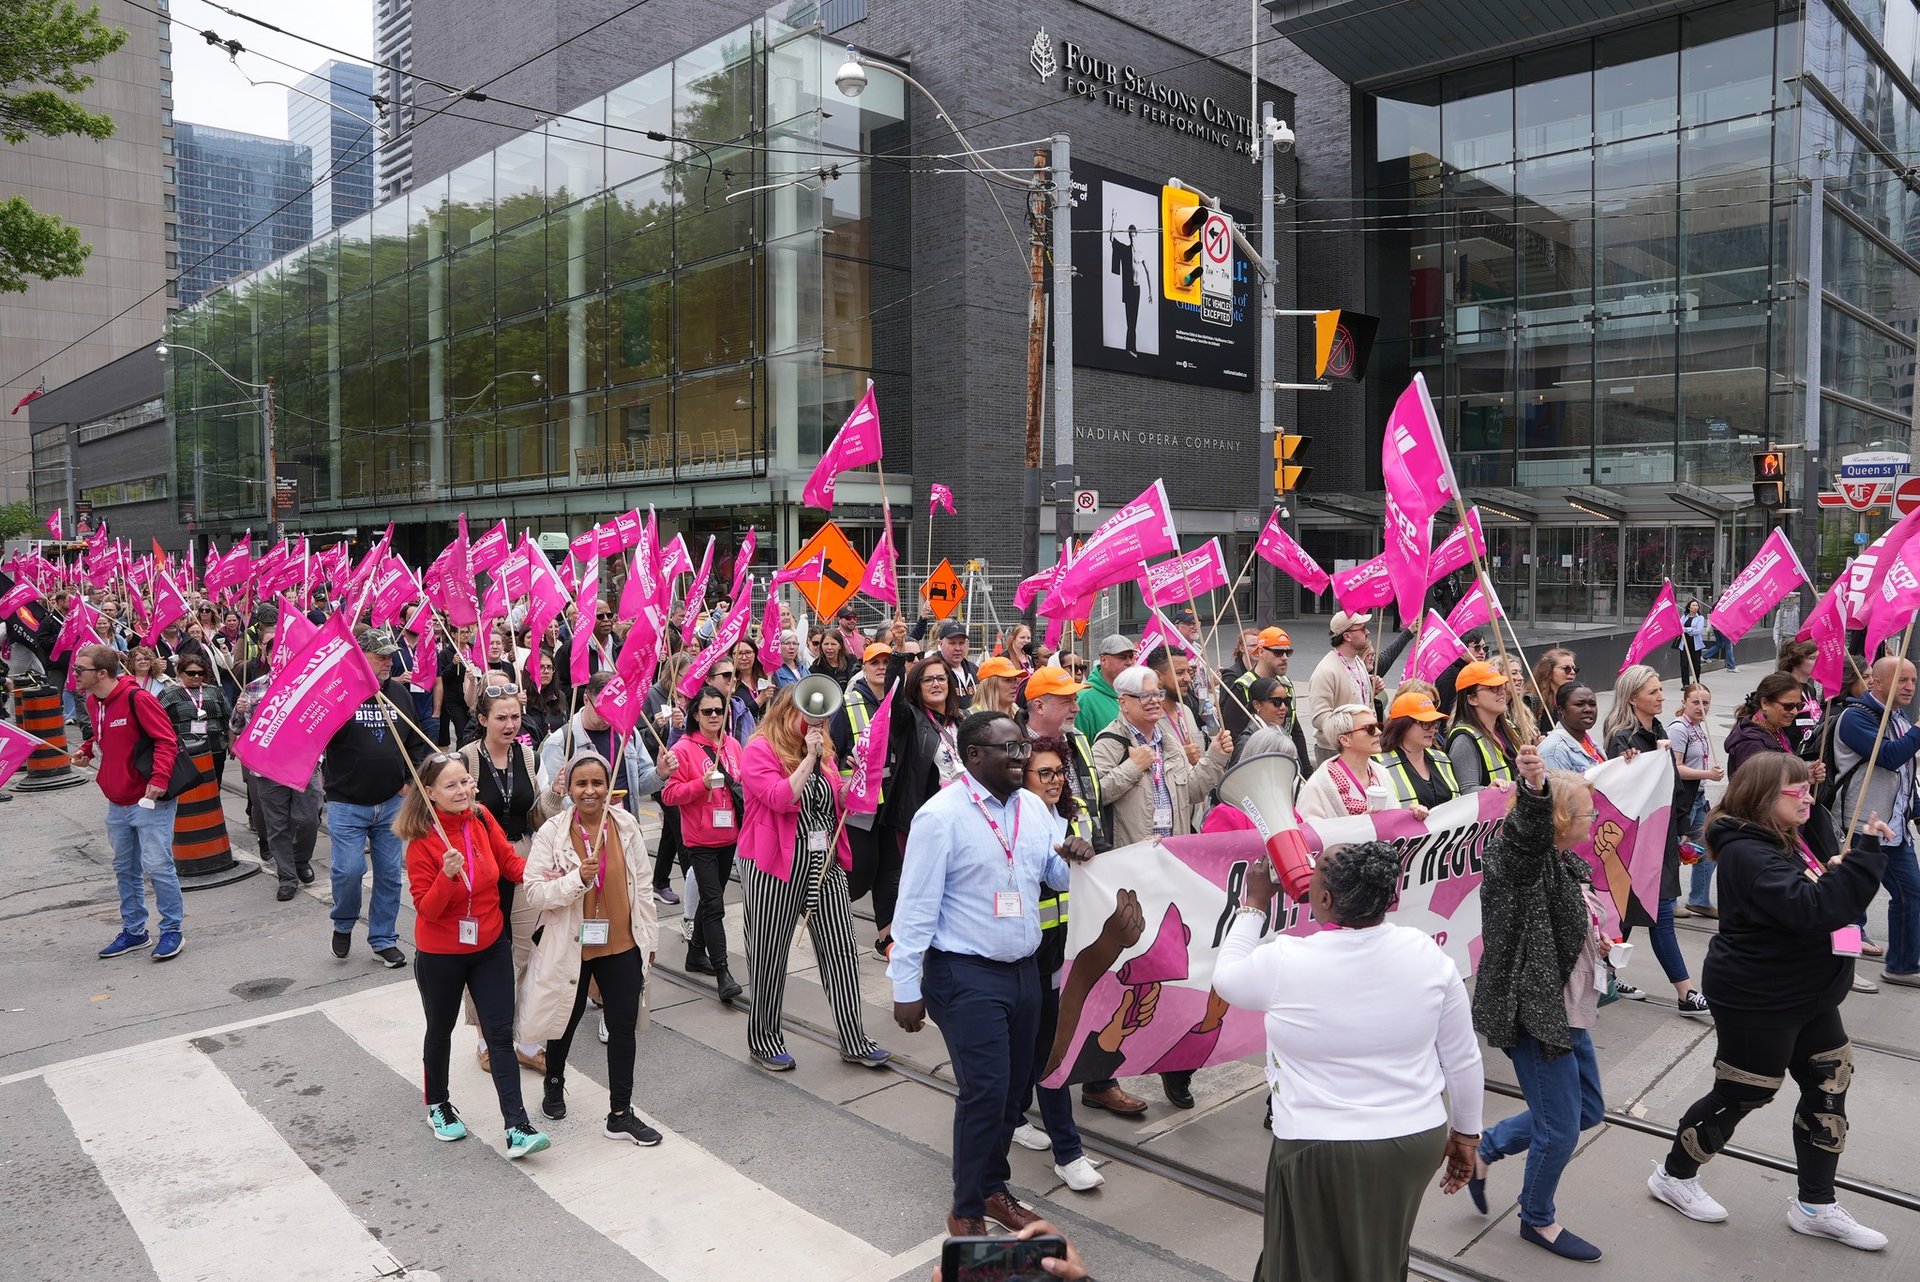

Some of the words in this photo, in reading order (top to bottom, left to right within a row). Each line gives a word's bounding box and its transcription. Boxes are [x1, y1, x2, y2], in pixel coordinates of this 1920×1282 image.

[1065, 41, 1117, 84] FOUR
[1124, 65, 1198, 115] SEASONS
[1068, 76, 1097, 99] FOR
[1107, 90, 1134, 112] THE
[1143, 103, 1229, 147] PERFORMING
[1236, 139, 1252, 156] AR
[1212, 298, 1232, 312] VEHICLES
[1238, 294, 1248, 307] of
[1203, 308, 1231, 322] EXCEPTED
[1076, 426, 1130, 442] NADIAN
[1138, 432, 1178, 446] OPERA
[1186, 437, 1240, 451] COMPANY
[1848, 466, 1880, 476] Queen
[1894, 464, 1904, 474] W
[853, 507, 866, 516] Box
[1243, 800, 1270, 836] AMPLIVOX
